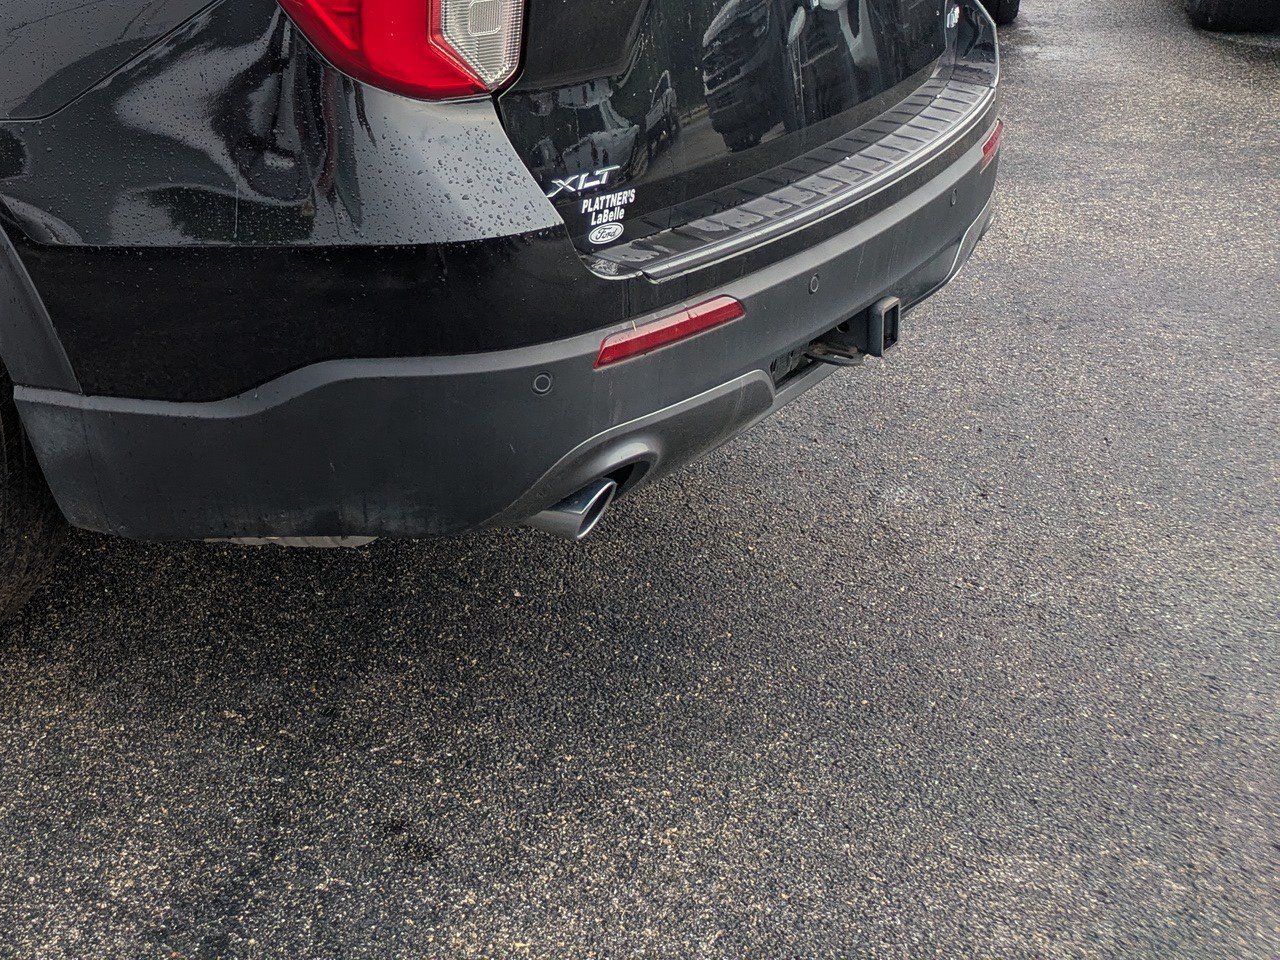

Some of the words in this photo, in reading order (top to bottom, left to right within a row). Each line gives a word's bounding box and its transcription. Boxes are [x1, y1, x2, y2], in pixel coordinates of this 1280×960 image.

[546, 165, 620, 198] XLT
[581, 188, 636, 214] PLATTNER'S
[590, 206, 625, 226] LaBelle
